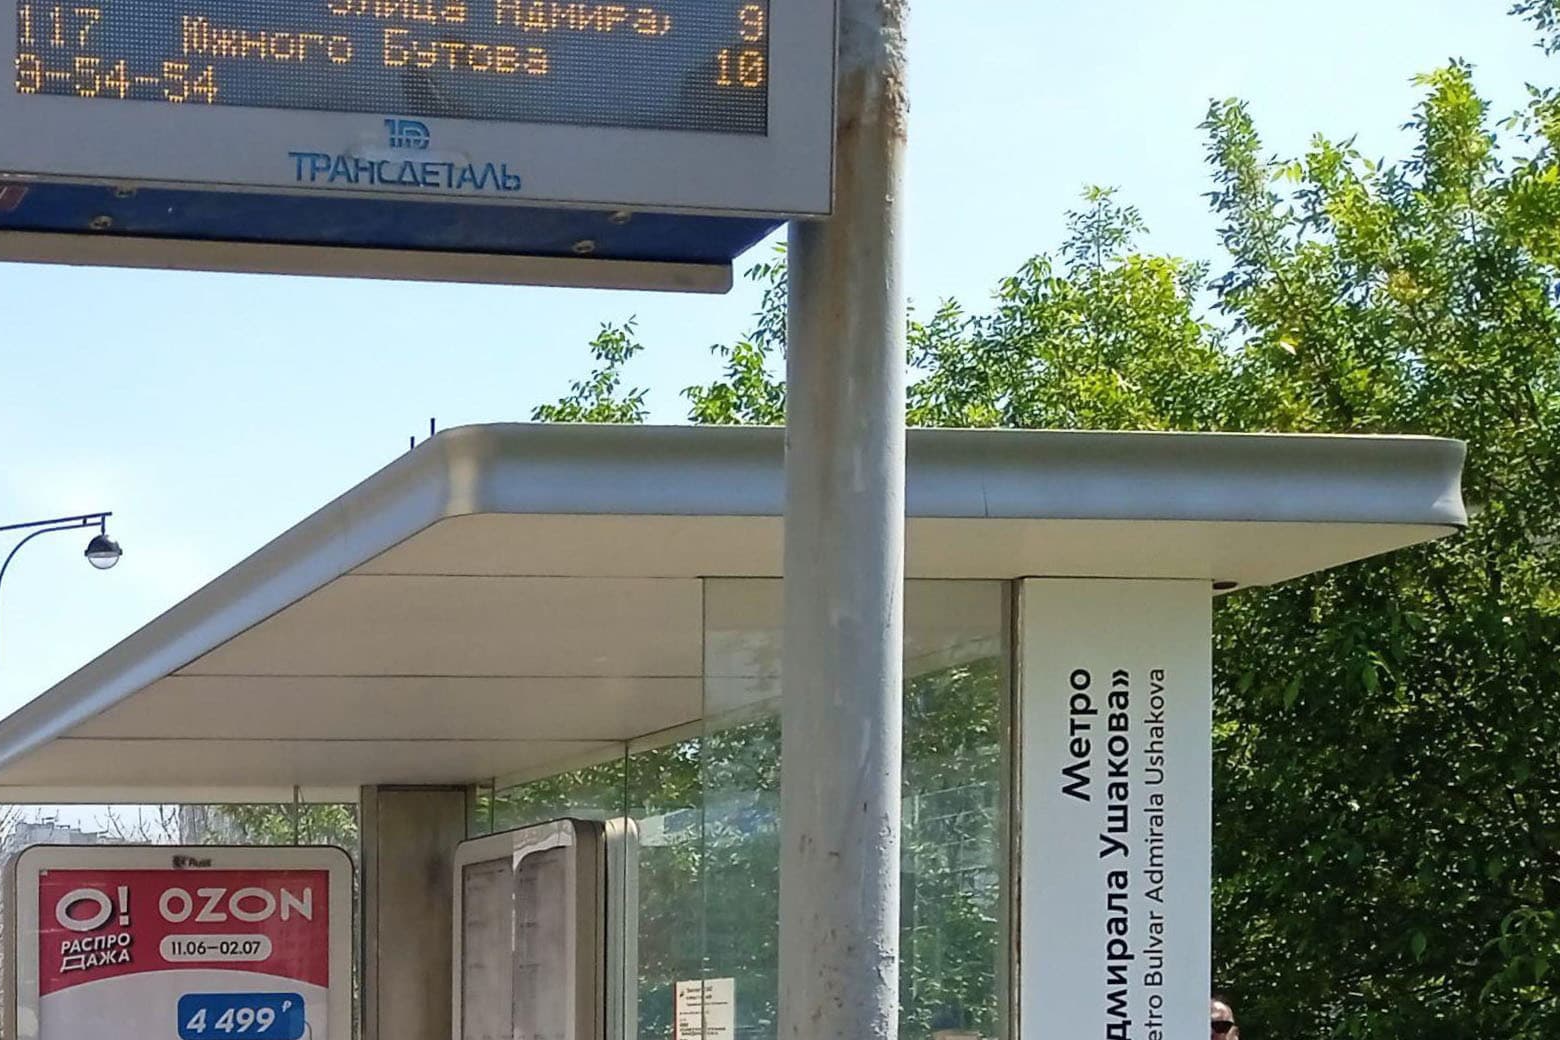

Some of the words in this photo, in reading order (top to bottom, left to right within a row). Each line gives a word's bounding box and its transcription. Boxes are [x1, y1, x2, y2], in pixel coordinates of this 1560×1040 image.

[19, 4, 101, 47] 117
[383, 28, 550, 75] Бутова
[716, 48, 765, 88] 10
[739, 4, 764, 42] 9
[288, 151, 522, 191] ТРАНСДЕТАЛЬ
[1061, 669, 1097, 801] Метро
[1143, 669, 1165, 786] Ushakova
[1098, 669, 1130, 858] Ушакова»
[1143, 792, 1165, 904] Admirala
[159, 887, 313, 922] OZON
[59, 952, 130, 973] ДАЖА
[60, 932, 131, 954] РАСПРО
[1143, 910, 1165, 988] Bulvar
[186, 1008, 206, 1033] 4
[214, 1007, 276, 1033] 499
